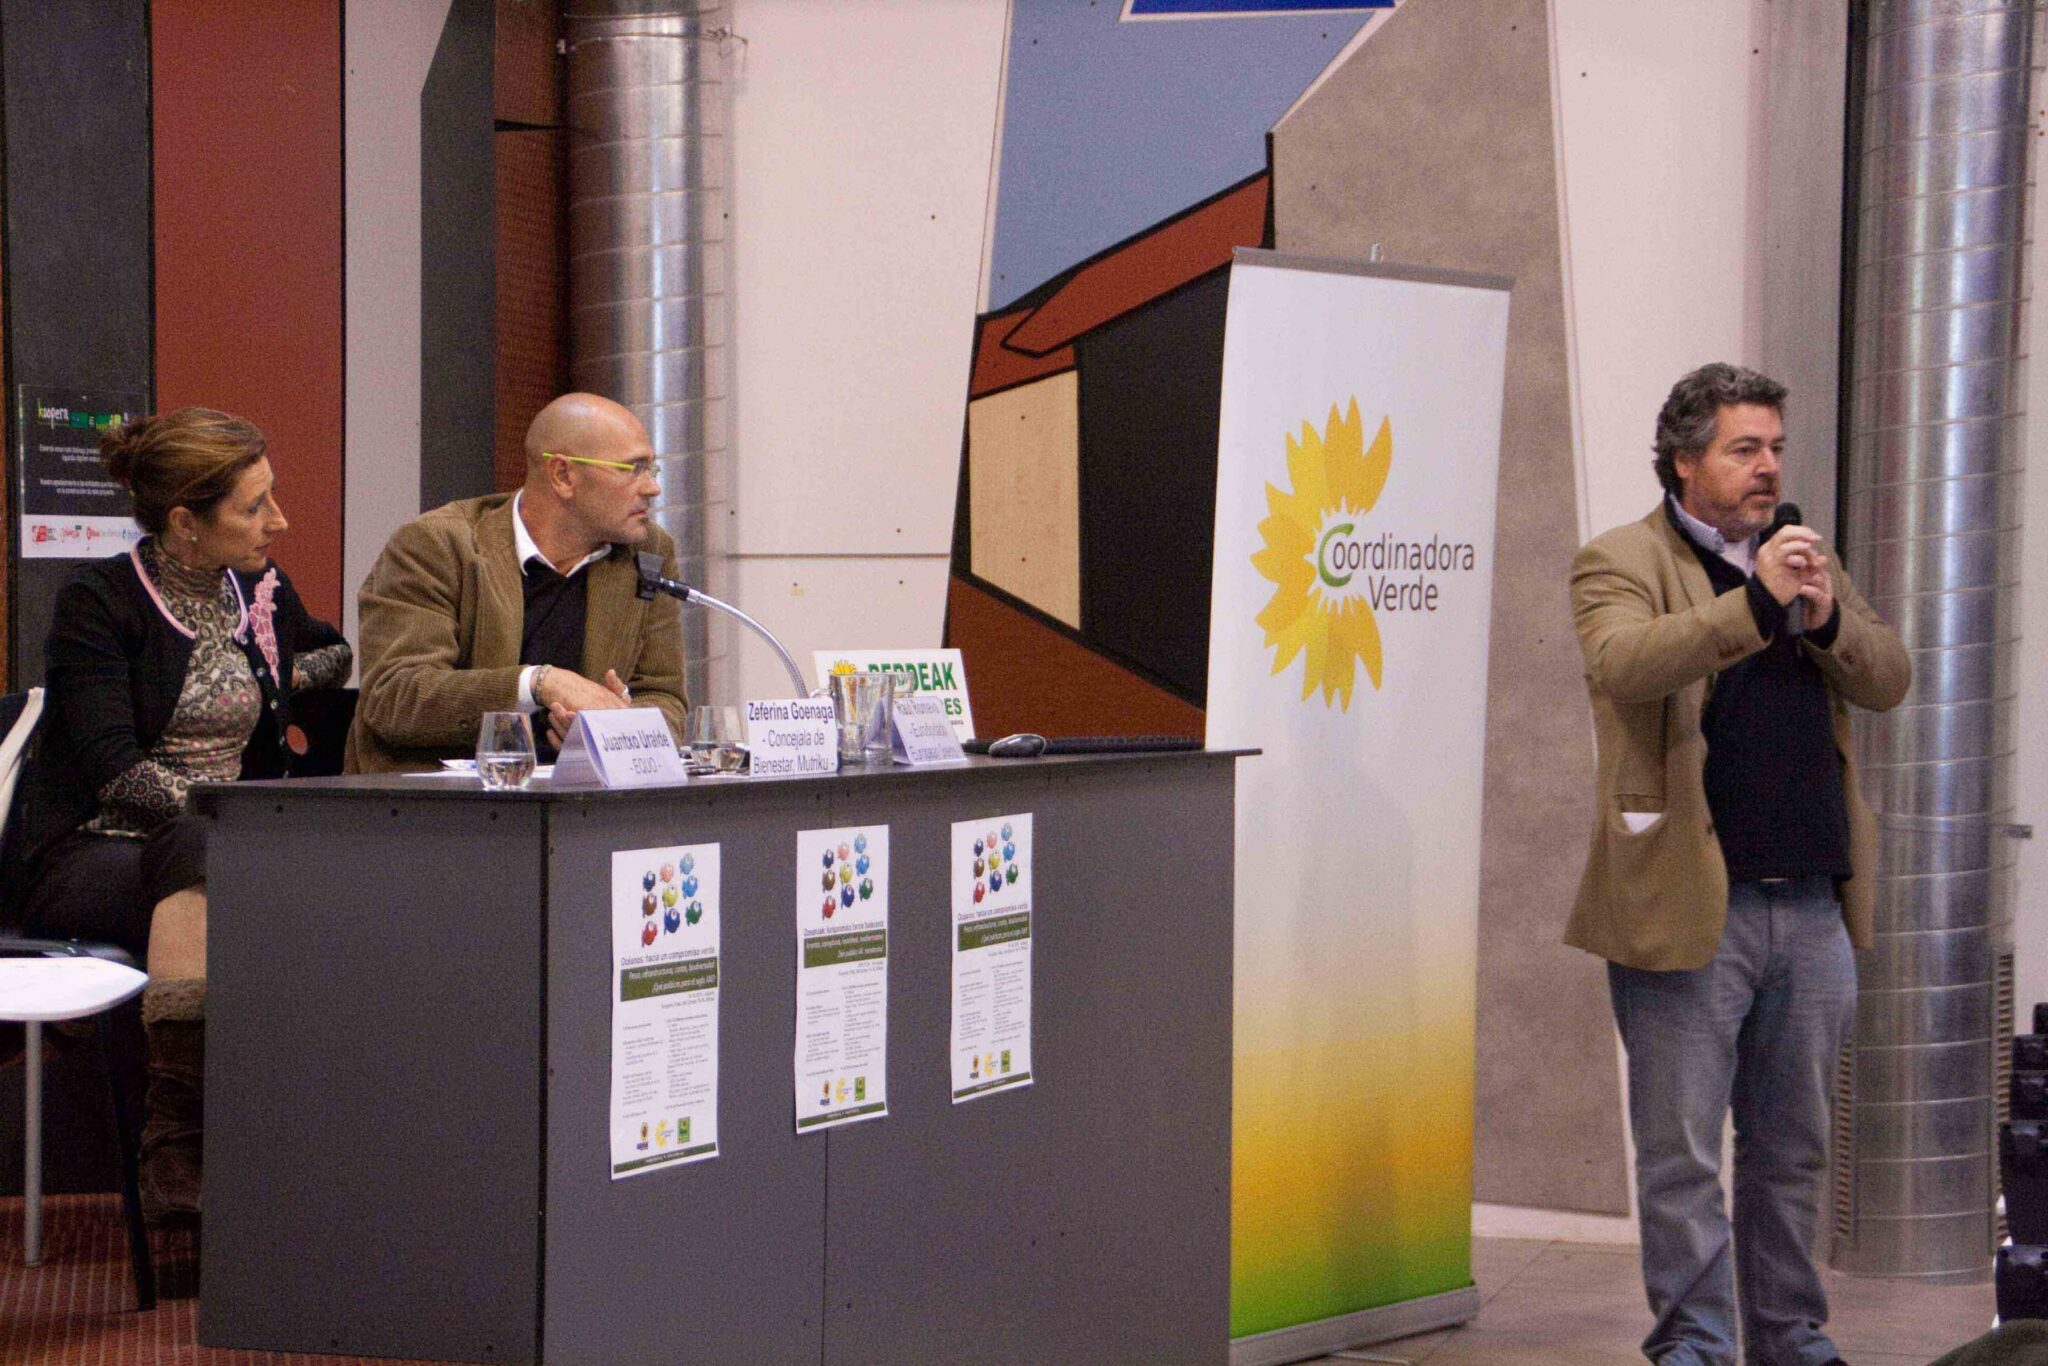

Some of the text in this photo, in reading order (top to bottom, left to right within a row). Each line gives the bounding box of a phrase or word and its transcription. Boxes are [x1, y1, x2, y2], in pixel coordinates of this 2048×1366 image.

[1318, 523, 1475, 587] Coordinadora
[1368, 575, 1439, 611] Verde
[748, 702, 834, 724] Zeferina Goenaga
[601, 730, 670, 752] Juantxo Uralde
[768, 730, 812, 750] Concejala
[814, 728, 825, 746] de
[797, 754, 829, 772] Mutriku
